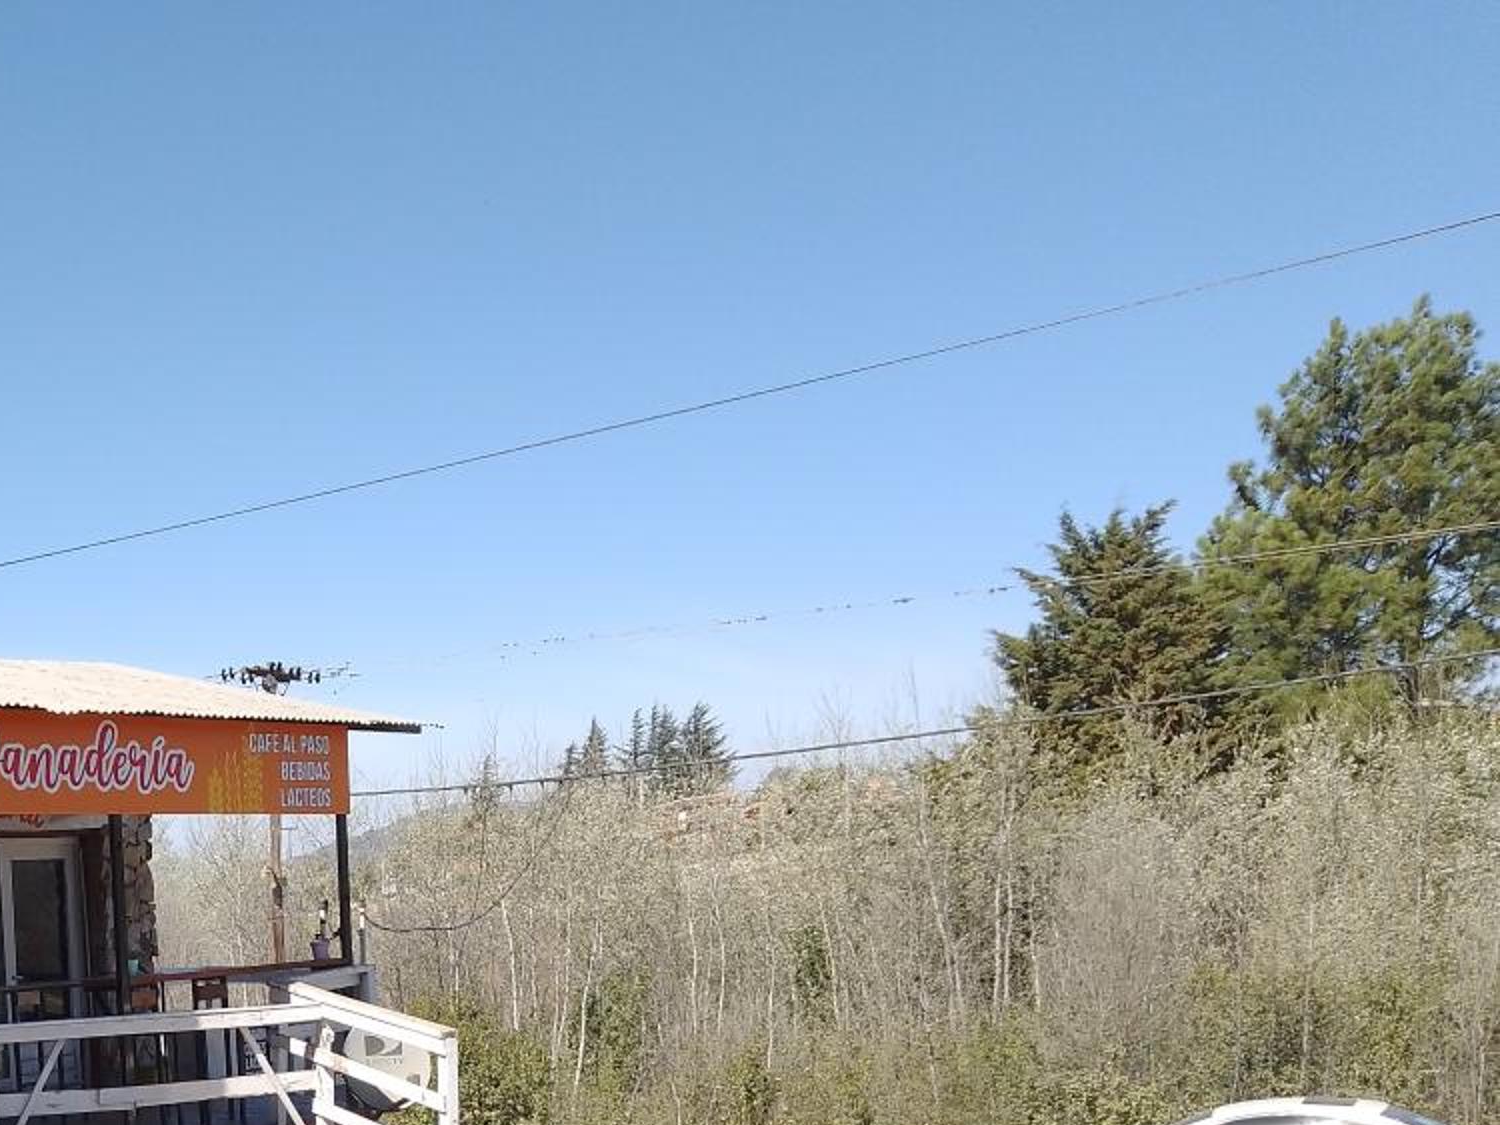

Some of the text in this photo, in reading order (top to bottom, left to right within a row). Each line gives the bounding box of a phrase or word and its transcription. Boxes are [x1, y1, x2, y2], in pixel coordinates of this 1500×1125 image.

[283, 734, 296, 753] AL
[299, 735, 329, 755] PASO
[281, 760, 330, 781] BEBIDAS
